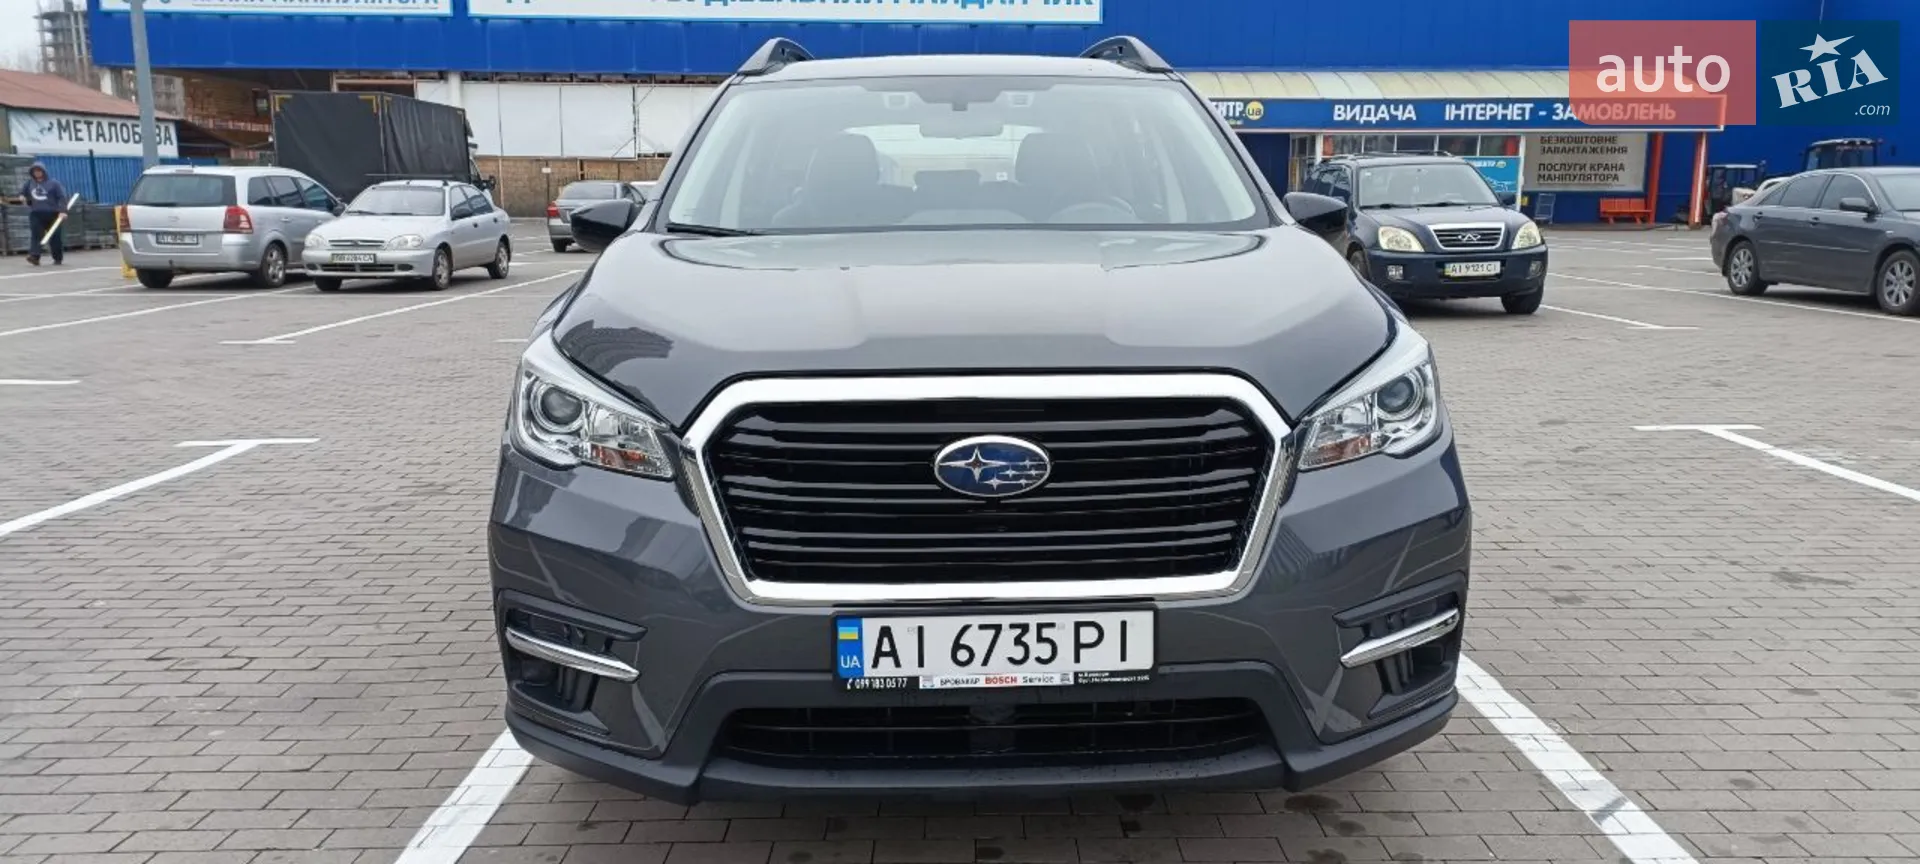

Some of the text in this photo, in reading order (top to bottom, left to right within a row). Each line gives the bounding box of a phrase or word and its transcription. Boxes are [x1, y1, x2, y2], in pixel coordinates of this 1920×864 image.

[1333, 103, 1416, 123] ВИДАЧА
[1445, 103, 1531, 122] ІНТЕРНЕТ
[1552, 103, 1677, 122] ЗАМОВЛЕНЬ
[56, 118, 174, 147] МЕТАЛОБЗА
[1540, 135, 1619, 145] БЕЗКОШТОВНЕ
[1540, 146, 1628, 155] ЗАВАНТАЖЕННЯ
[1538, 163, 1625, 172] ПОСЛУГИ КРАНА
[1537, 173, 1620, 182] МАНІПУЛЯТОРА
[871, 620, 1127, 669] AI 6735 PI
[840, 655, 861, 668] UA
[985, 674, 1055, 685] BOSCH Service
